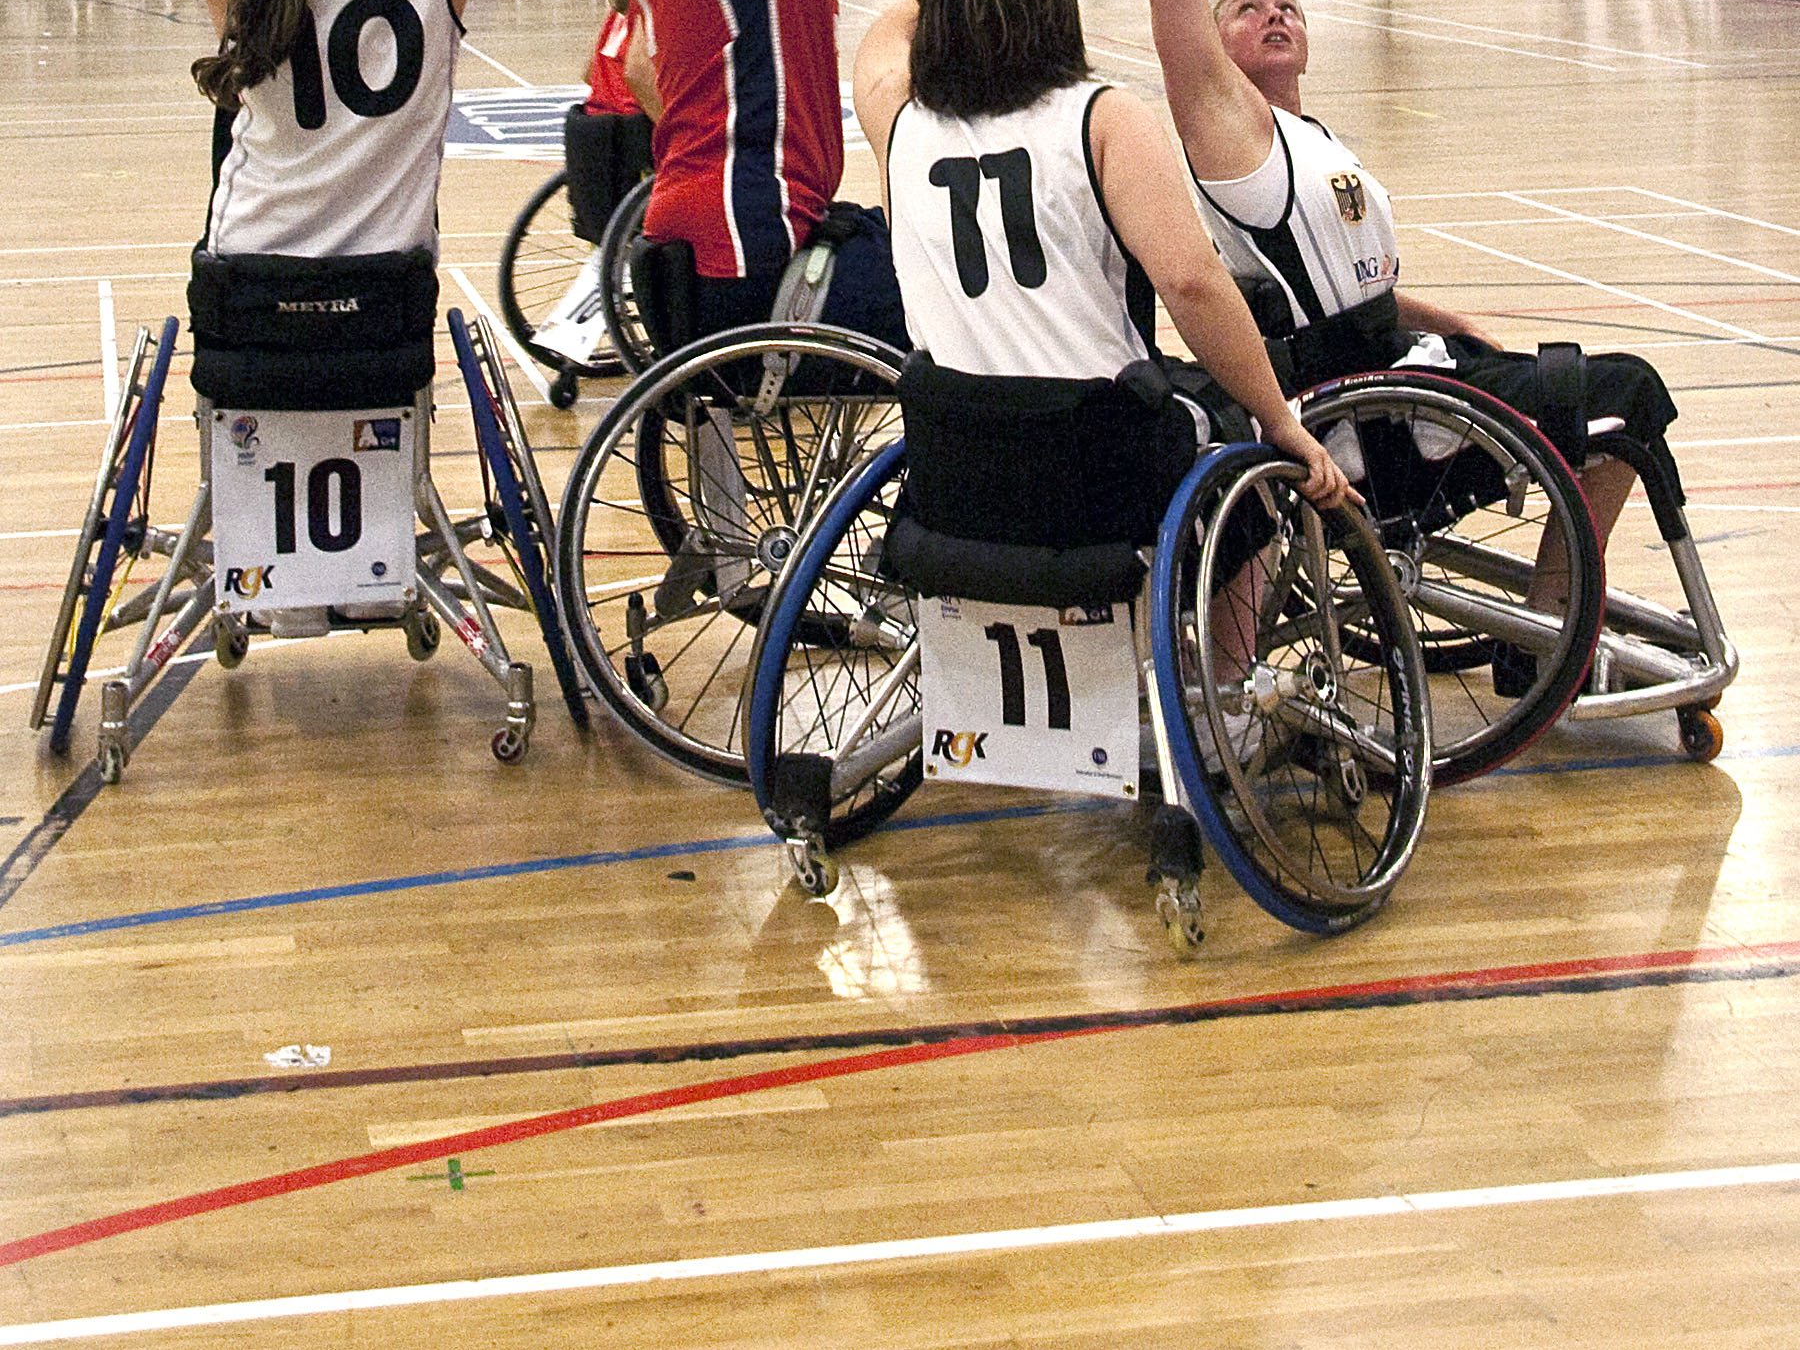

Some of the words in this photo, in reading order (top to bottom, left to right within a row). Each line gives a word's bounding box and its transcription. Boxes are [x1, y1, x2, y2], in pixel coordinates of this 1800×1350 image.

[928, 146, 1048, 299] 11
[1353, 256, 1379, 283] ING
[278, 297, 360, 313] MEYRA
[264, 457, 362, 555] 10
[984, 621, 1072, 732] 11
